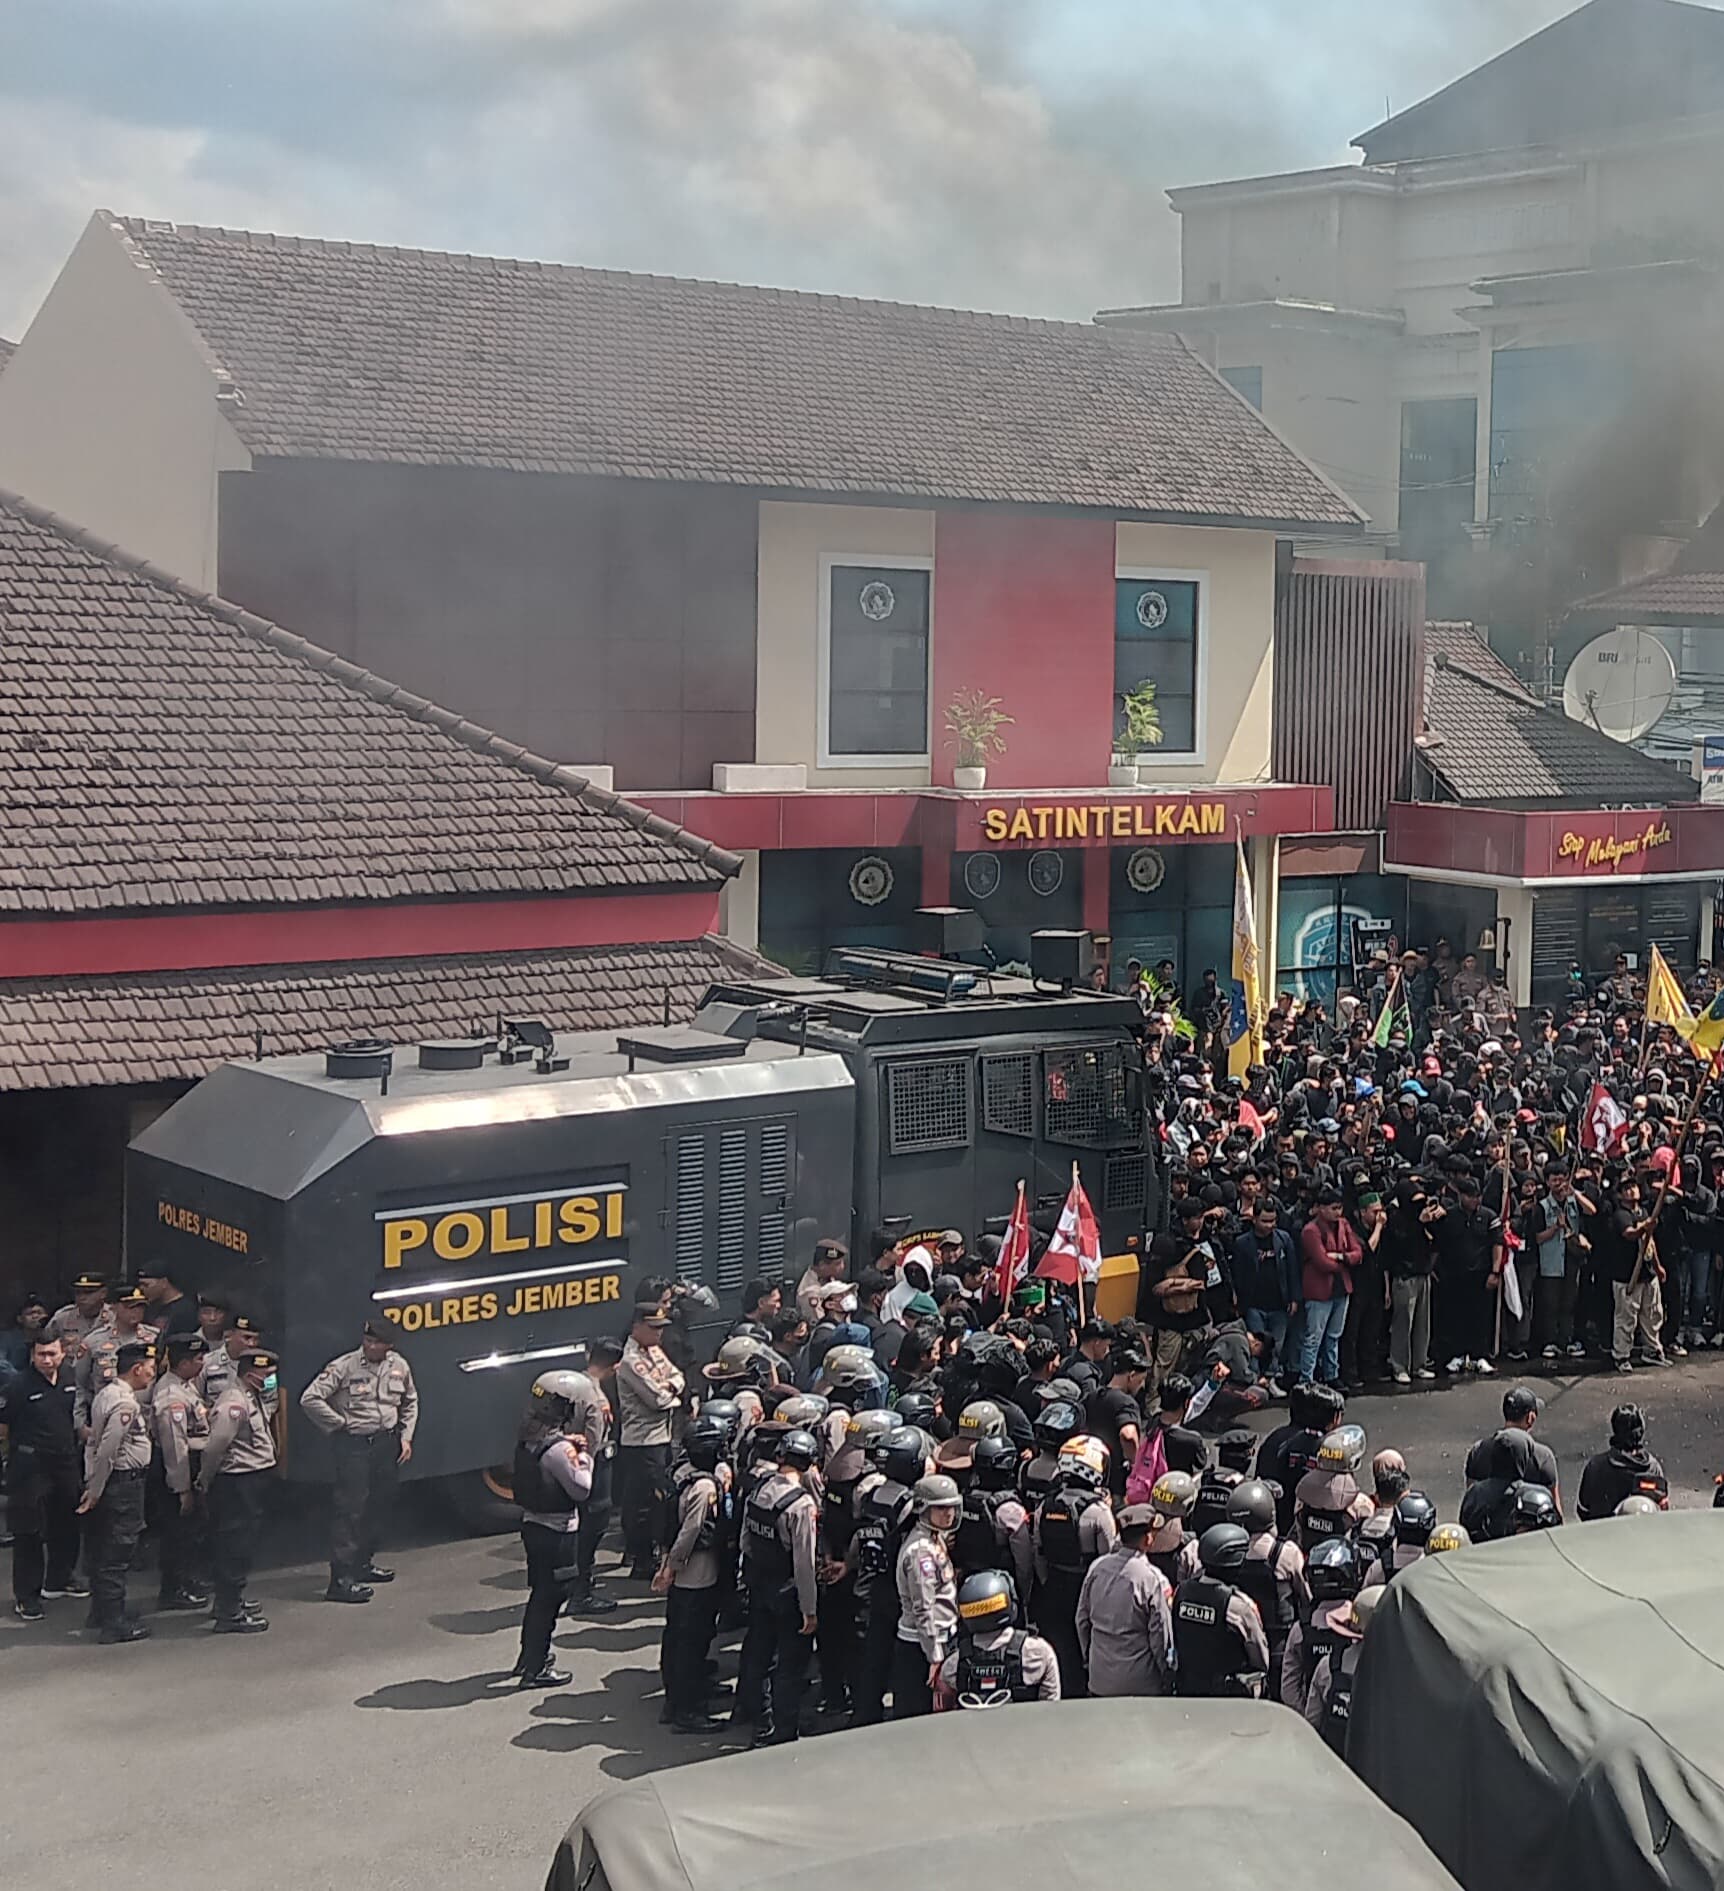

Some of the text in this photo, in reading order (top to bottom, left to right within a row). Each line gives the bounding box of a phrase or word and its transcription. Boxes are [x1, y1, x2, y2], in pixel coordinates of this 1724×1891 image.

[985, 803, 1226, 840] SATINTELKAM
[159, 1200, 248, 1254] POLRES JEMBER
[384, 1193, 623, 1268] POLISI
[384, 1275, 620, 1332] POLRES JEMBER
[1429, 1537, 1460, 1550] POLISI
[1333, 1704, 1349, 1718] POL
